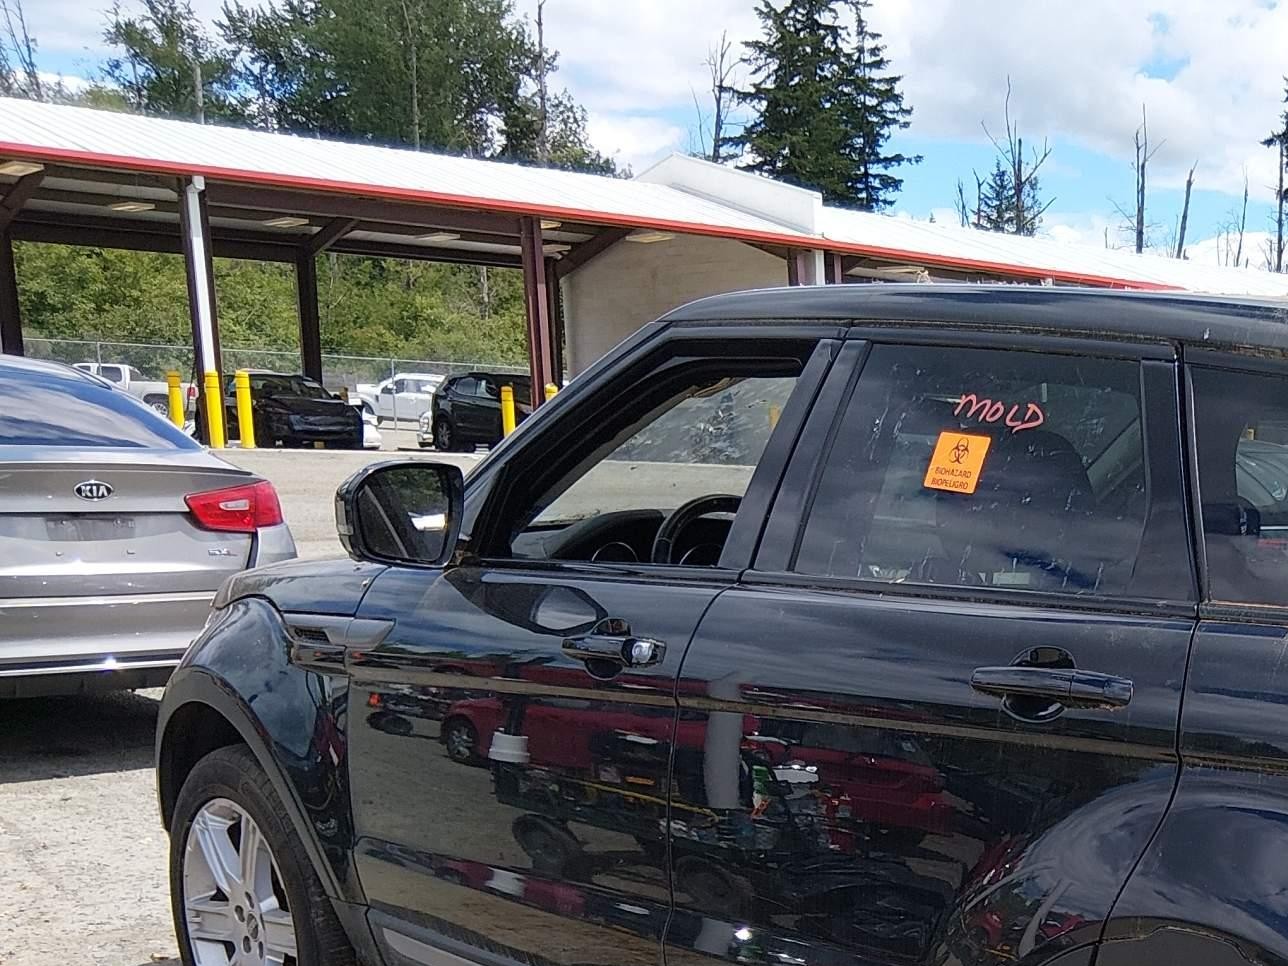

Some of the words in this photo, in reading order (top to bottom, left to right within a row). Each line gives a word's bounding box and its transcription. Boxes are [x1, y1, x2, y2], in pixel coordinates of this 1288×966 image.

[954, 393, 1045, 434] MOLD
[934, 466, 973, 479] BIOHAZARD
[930, 477, 969, 490] BIOPELIGRO
[80, 485, 109, 497] KIA
